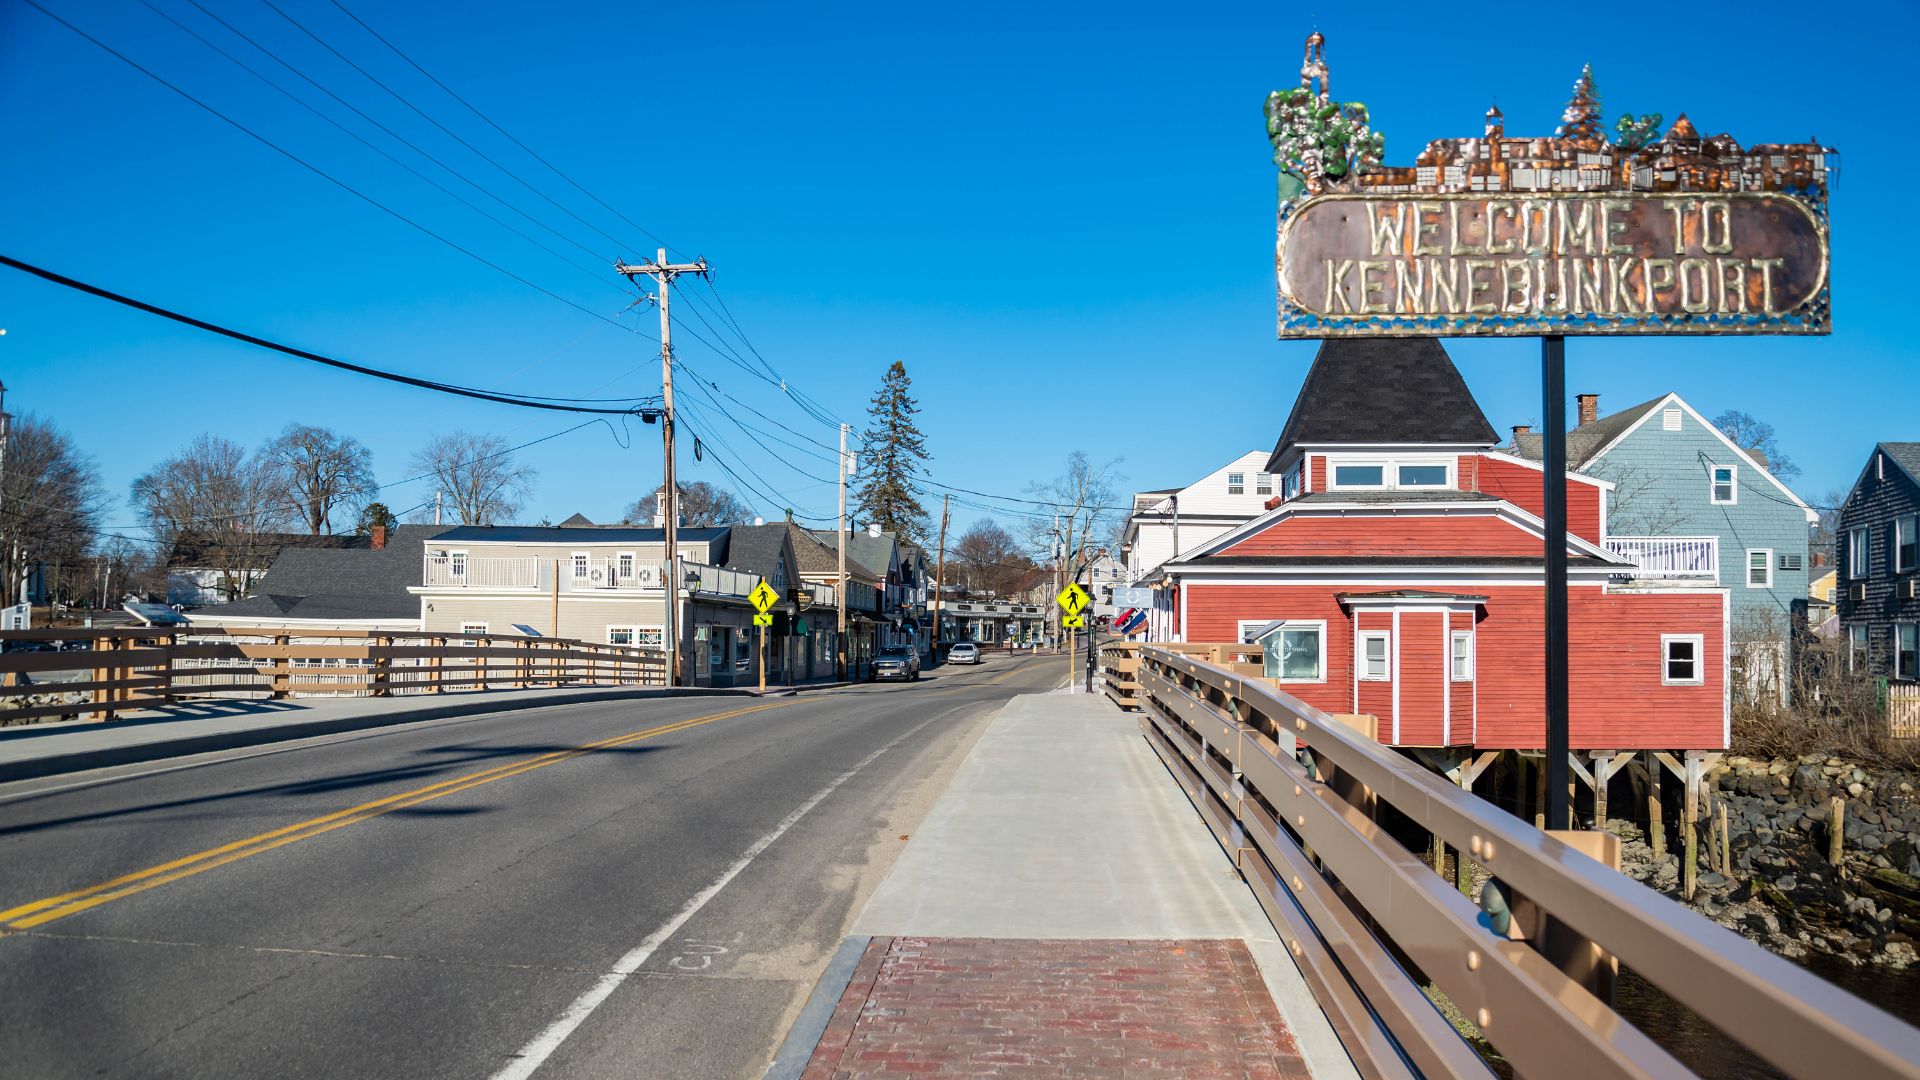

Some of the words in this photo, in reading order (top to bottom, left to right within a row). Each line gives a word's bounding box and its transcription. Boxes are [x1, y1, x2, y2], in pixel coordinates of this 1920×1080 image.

[1366, 200, 1633, 256] WELCOME
[1664, 200, 1733, 255] TO
[1325, 258, 1784, 314] KENNEBUNKPORT
